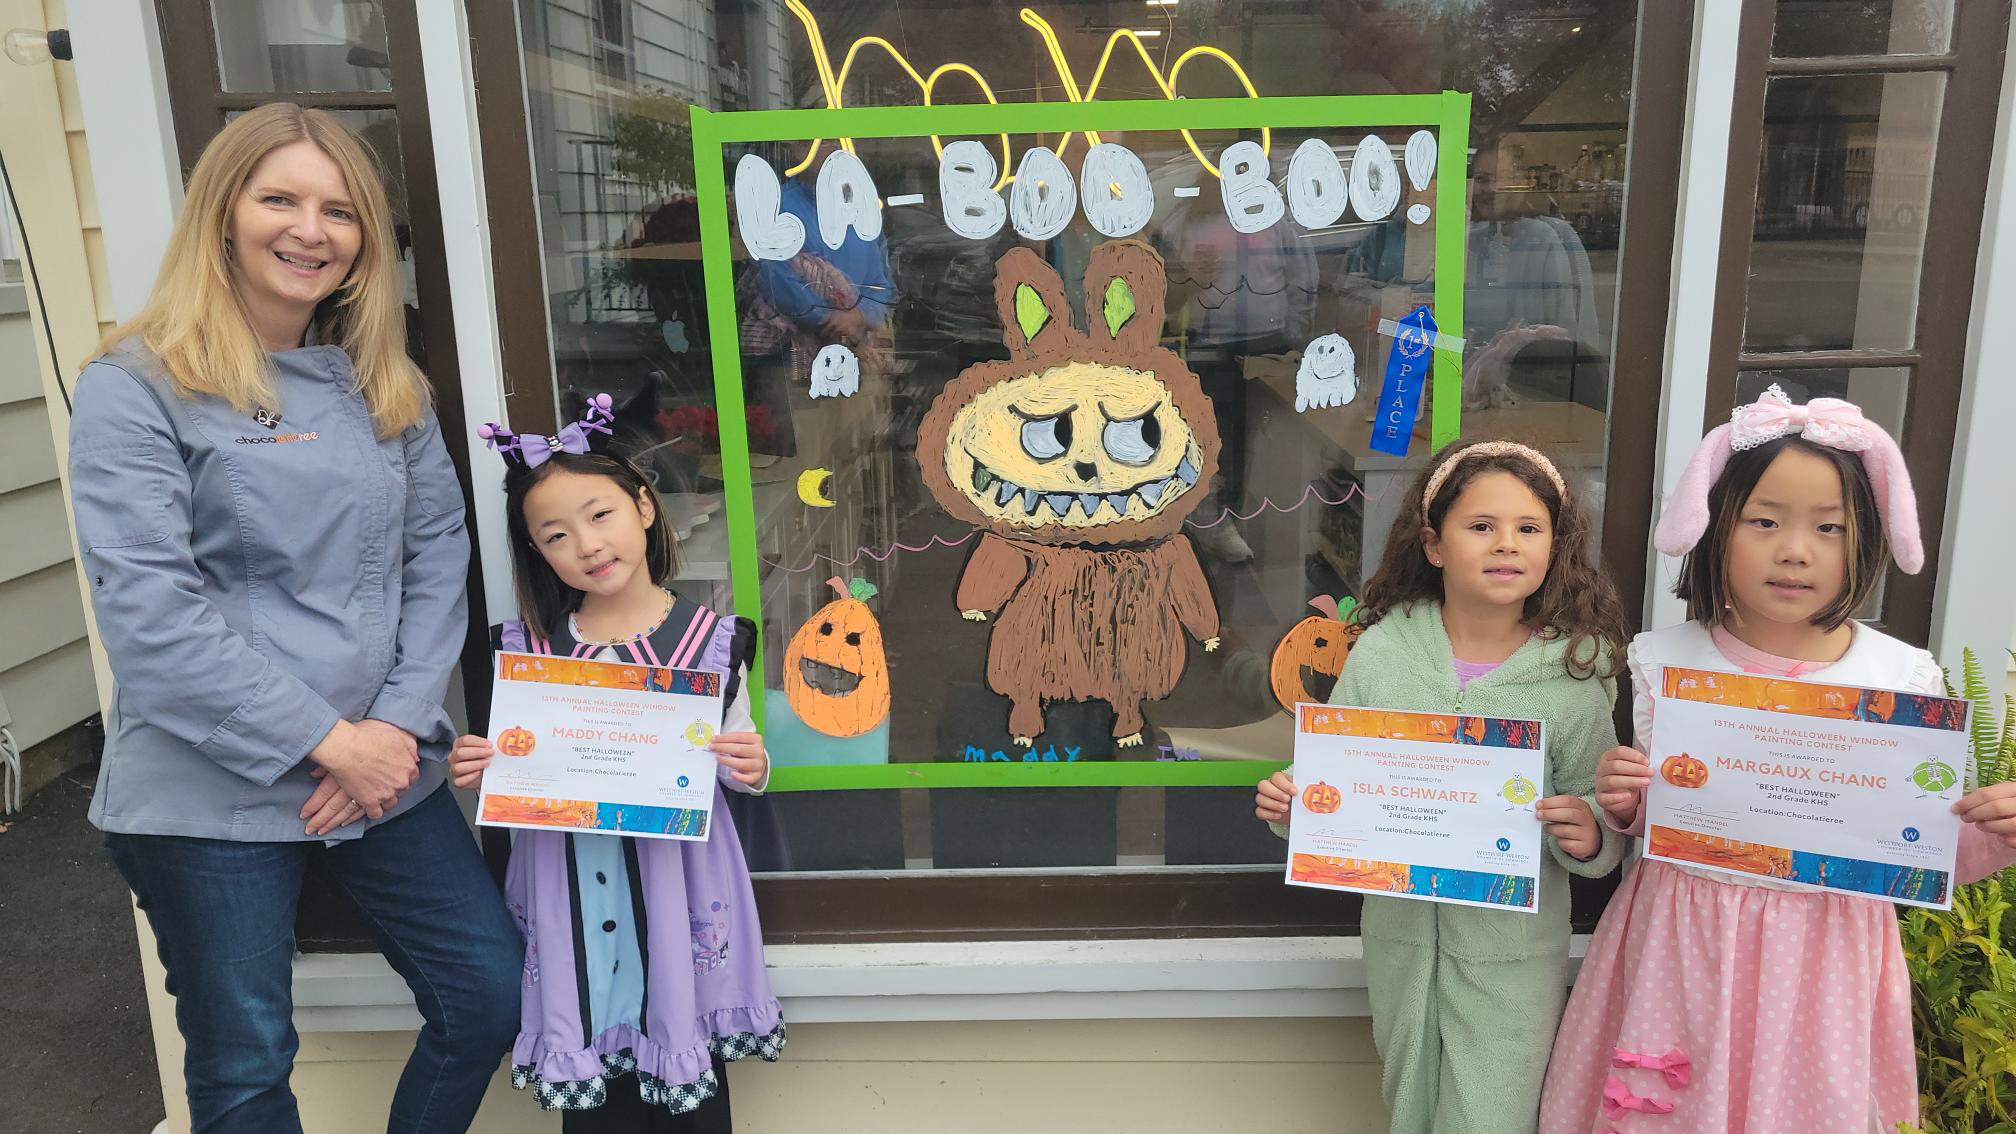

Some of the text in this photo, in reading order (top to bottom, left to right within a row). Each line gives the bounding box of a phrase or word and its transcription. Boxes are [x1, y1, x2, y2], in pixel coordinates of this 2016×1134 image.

[1407, 335, 1421, 350] 1st
[1385, 363, 1413, 439] PLACE
[560, 696, 591, 705] ANNUAL
[594, 699, 640, 709] HALLOWEEN
[642, 703, 676, 712] WINDOW
[572, 705, 644, 717] PAINTING CONTEST
[552, 727, 659, 745] MADDY CHANG
[1714, 719, 1899, 748] 13TH ANNUAL HALLOWEEN WINDOW
[1754, 734, 1852, 752] PAINTING CONTEST
[571, 746, 635, 756] "BEST HALLOWEEN"
[593, 754, 612, 762] Grade
[1364, 751, 1398, 760] ANNUAL
[1400, 753, 1450, 764] HALLOWEEN
[1452, 758, 1491, 767] WINDOW
[1377, 759, 1455, 772] PAINTING CONTEST
[1791, 754, 1825, 763] AWARDED
[1407, 775, 1434, 783] AWARDED
[1716, 756, 1888, 790] MARGAUX CHANG
[1352, 782, 1478, 804] ISLA SCHWARTZ
[1755, 782, 1841, 799] "BEST HALLOWEEN"
[1767, 792, 1829, 806] 2nd Grade KHS
[1379, 803, 1447, 815] "BEST HALLOWEEN"
[1749, 806, 1844, 825] Location:Chocolatieree
[1402, 813, 1422, 821] Grade
[1674, 813, 1728, 827] MATTHEW MANDEL
[1374, 825, 1451, 839] Location:Chocolatieree
